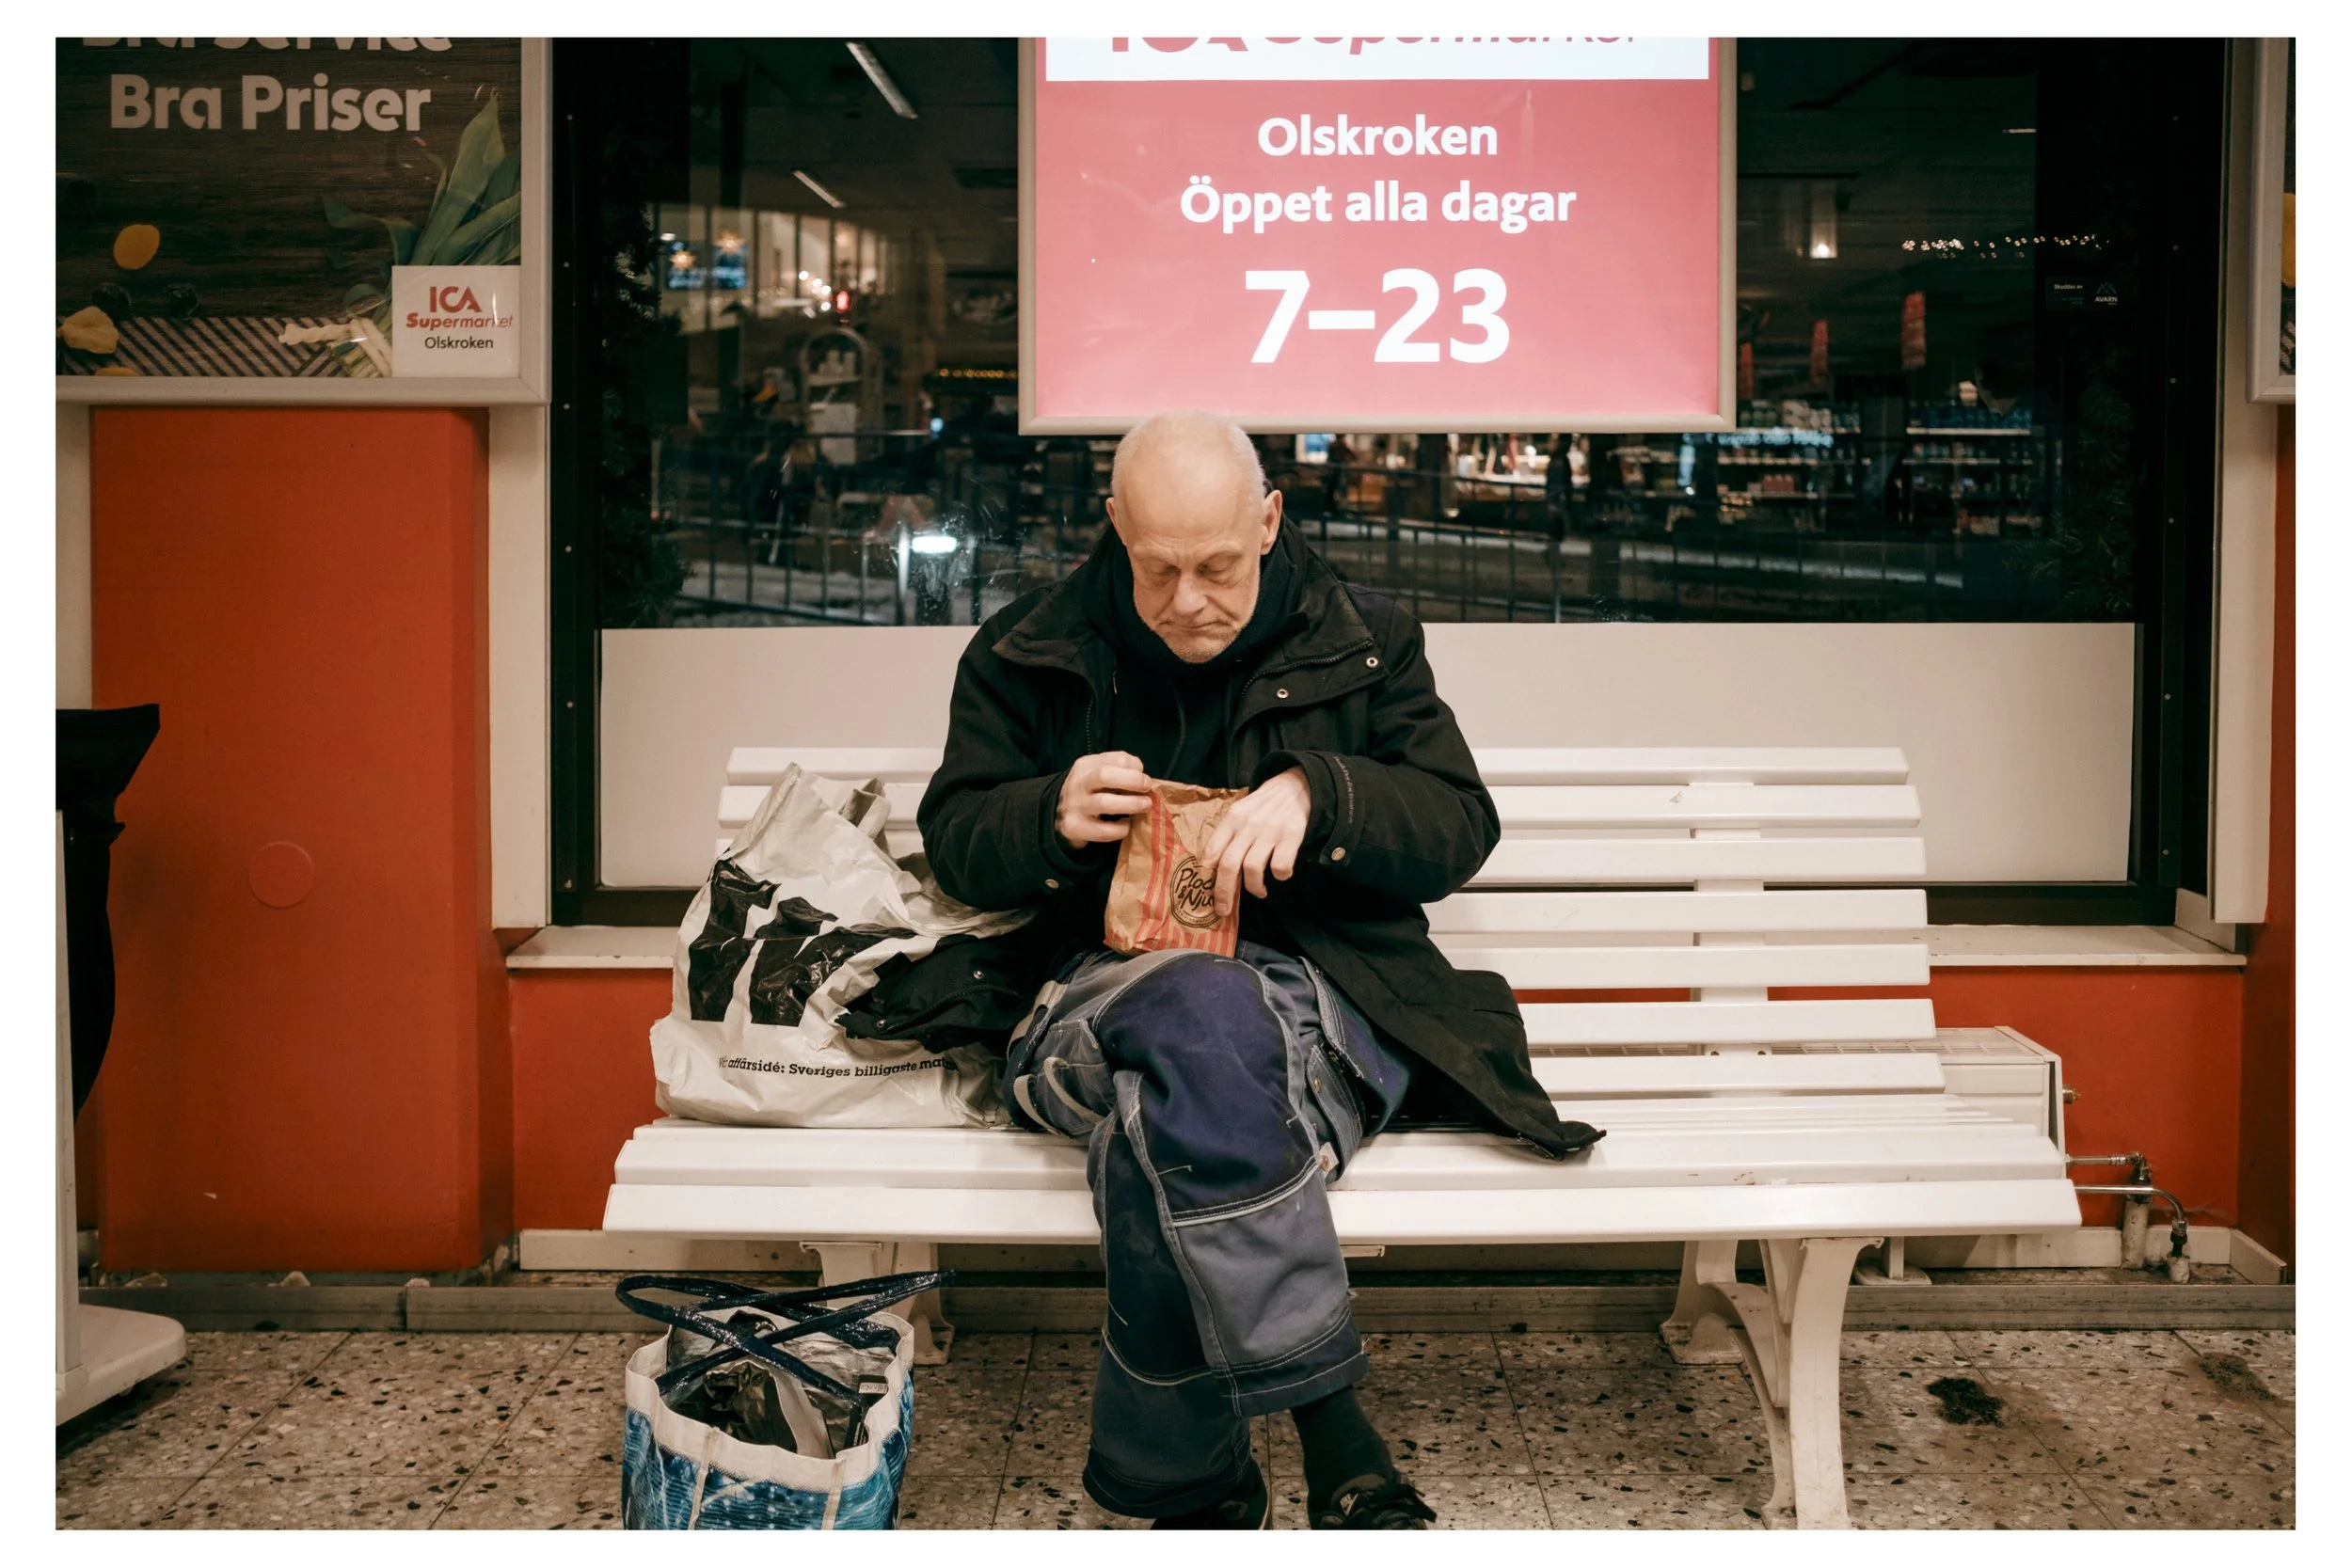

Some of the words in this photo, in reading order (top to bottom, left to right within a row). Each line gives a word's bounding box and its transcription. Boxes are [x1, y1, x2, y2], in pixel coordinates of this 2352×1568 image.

[110, 73, 221, 130] Bra
[242, 72, 431, 132] Priser
[1258, 114, 1498, 157] Olskroken
[1180, 175, 1333, 233] Öppet
[1345, 181, 1428, 222] alla
[1441, 181, 1577, 233] dagar
[429, 286, 482, 312] ICA
[405, 312, 514, 331] Supermarket
[424, 336, 494, 349] Olskroken
[727, 1057, 786, 1073] affärsidé:
[788, 1063, 850, 1078] Sveriges
[854, 1062, 917, 1077] billigaste
